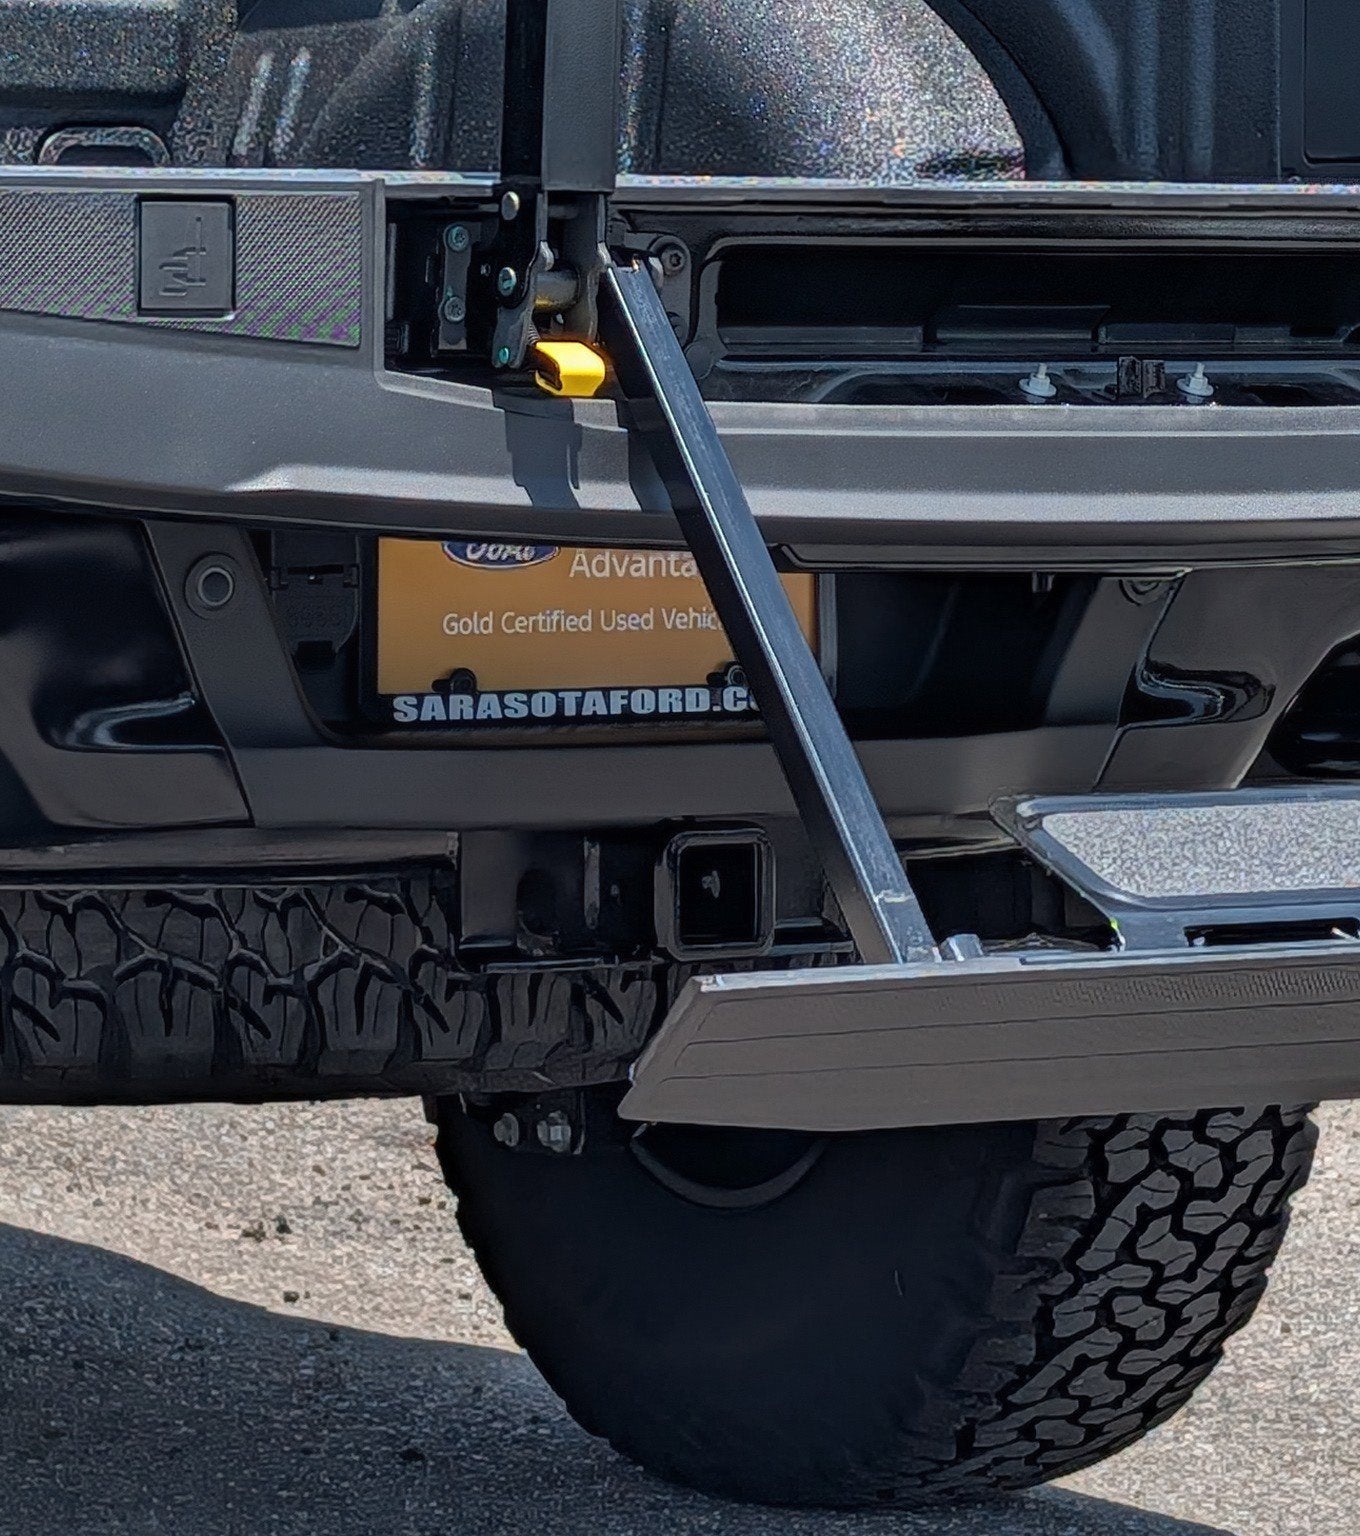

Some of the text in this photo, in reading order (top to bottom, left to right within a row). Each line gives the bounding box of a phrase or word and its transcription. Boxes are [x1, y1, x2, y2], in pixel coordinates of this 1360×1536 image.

[442, 606, 724, 635] Gold Certified Used Vehic
